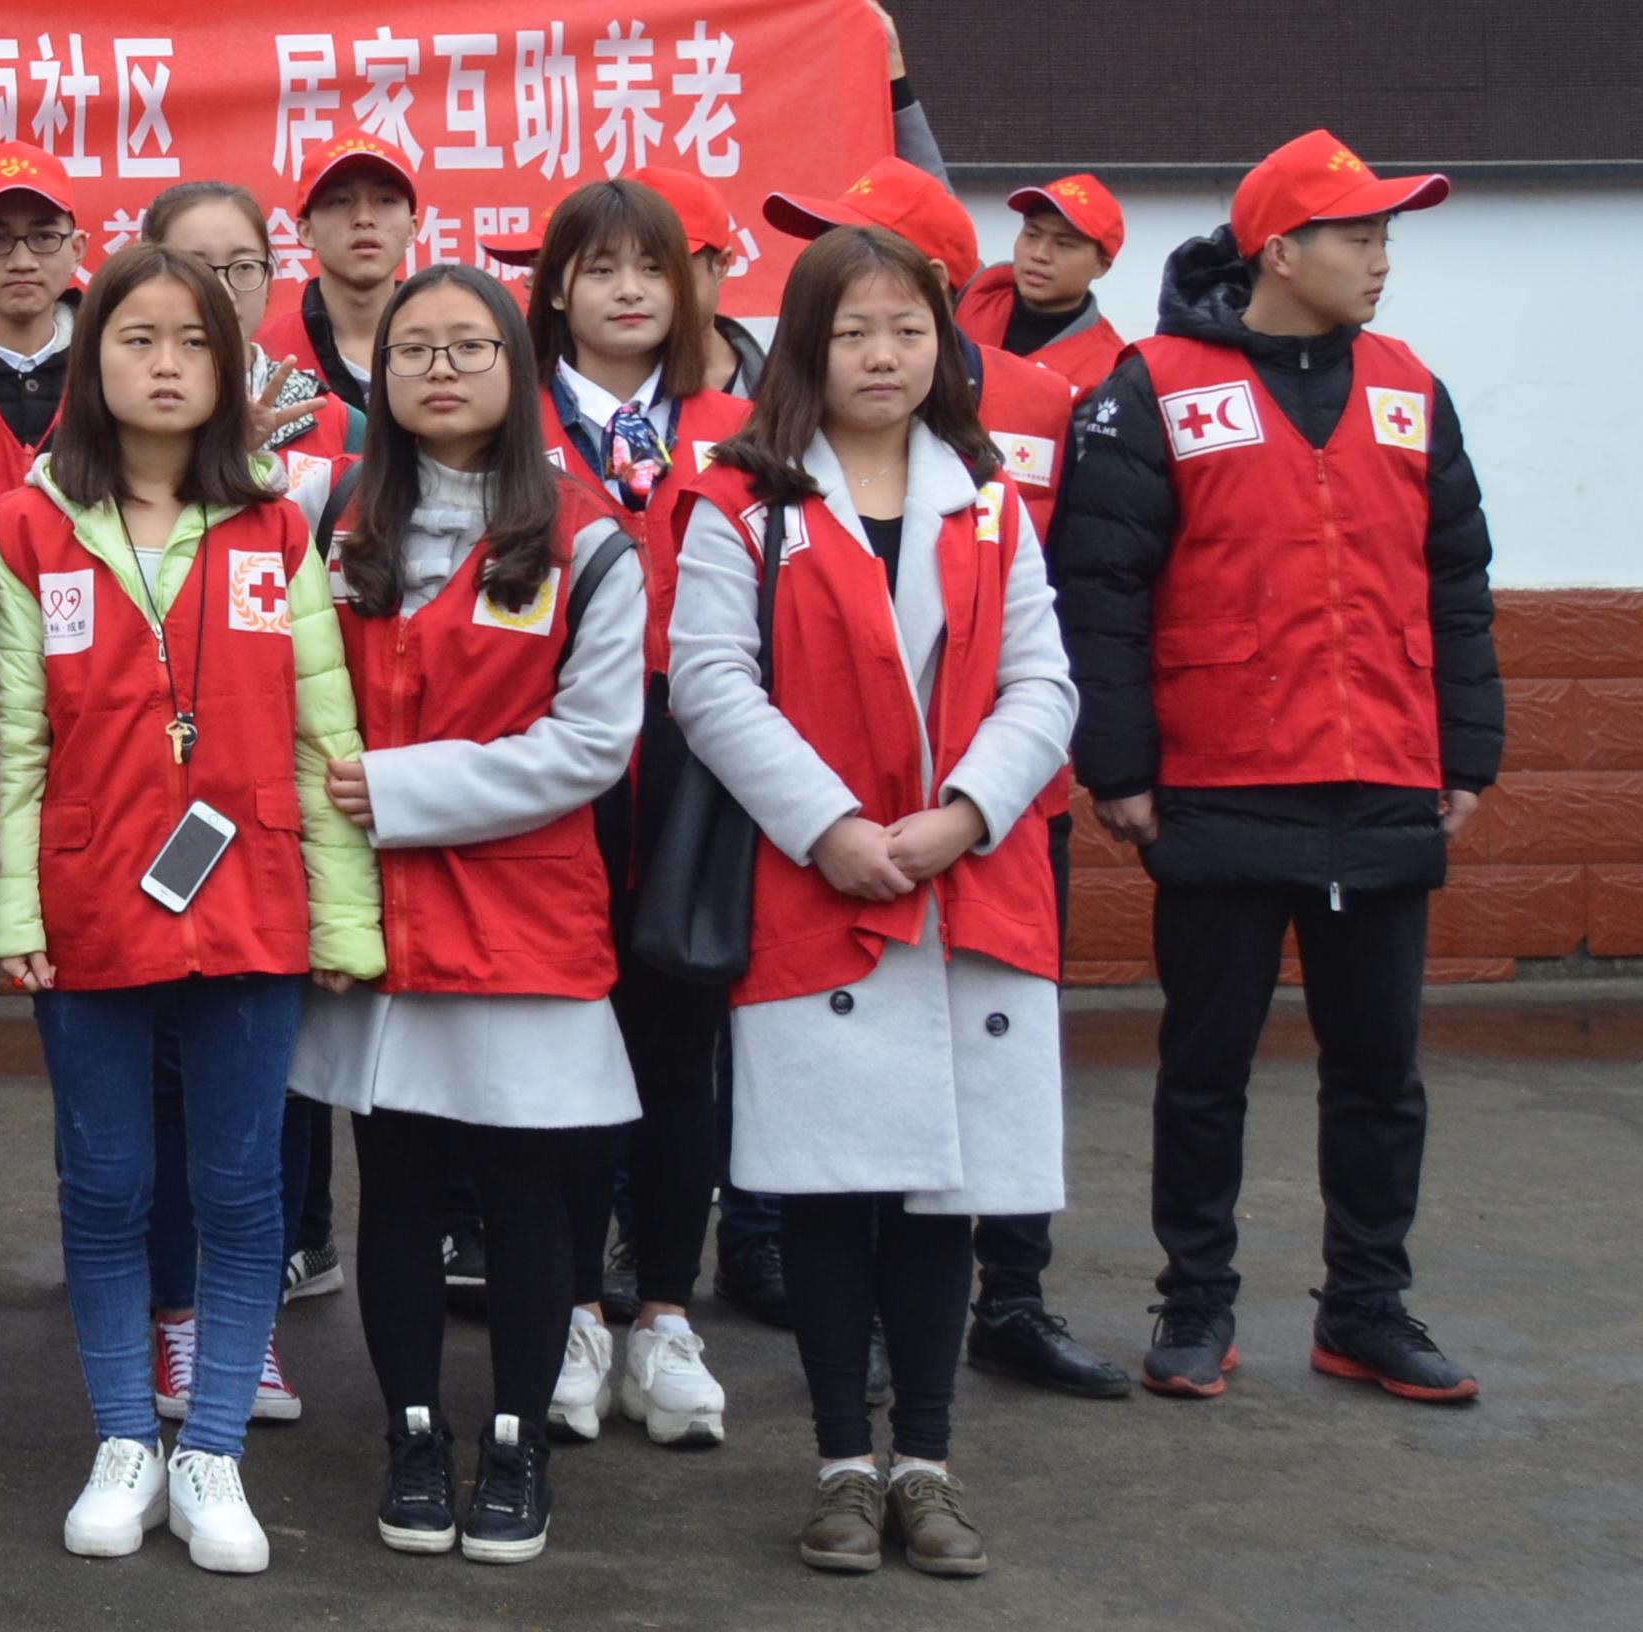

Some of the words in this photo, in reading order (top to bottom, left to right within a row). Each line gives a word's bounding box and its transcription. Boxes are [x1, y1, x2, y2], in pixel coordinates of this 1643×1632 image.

[272, 19, 742, 180] 居家互助养老
